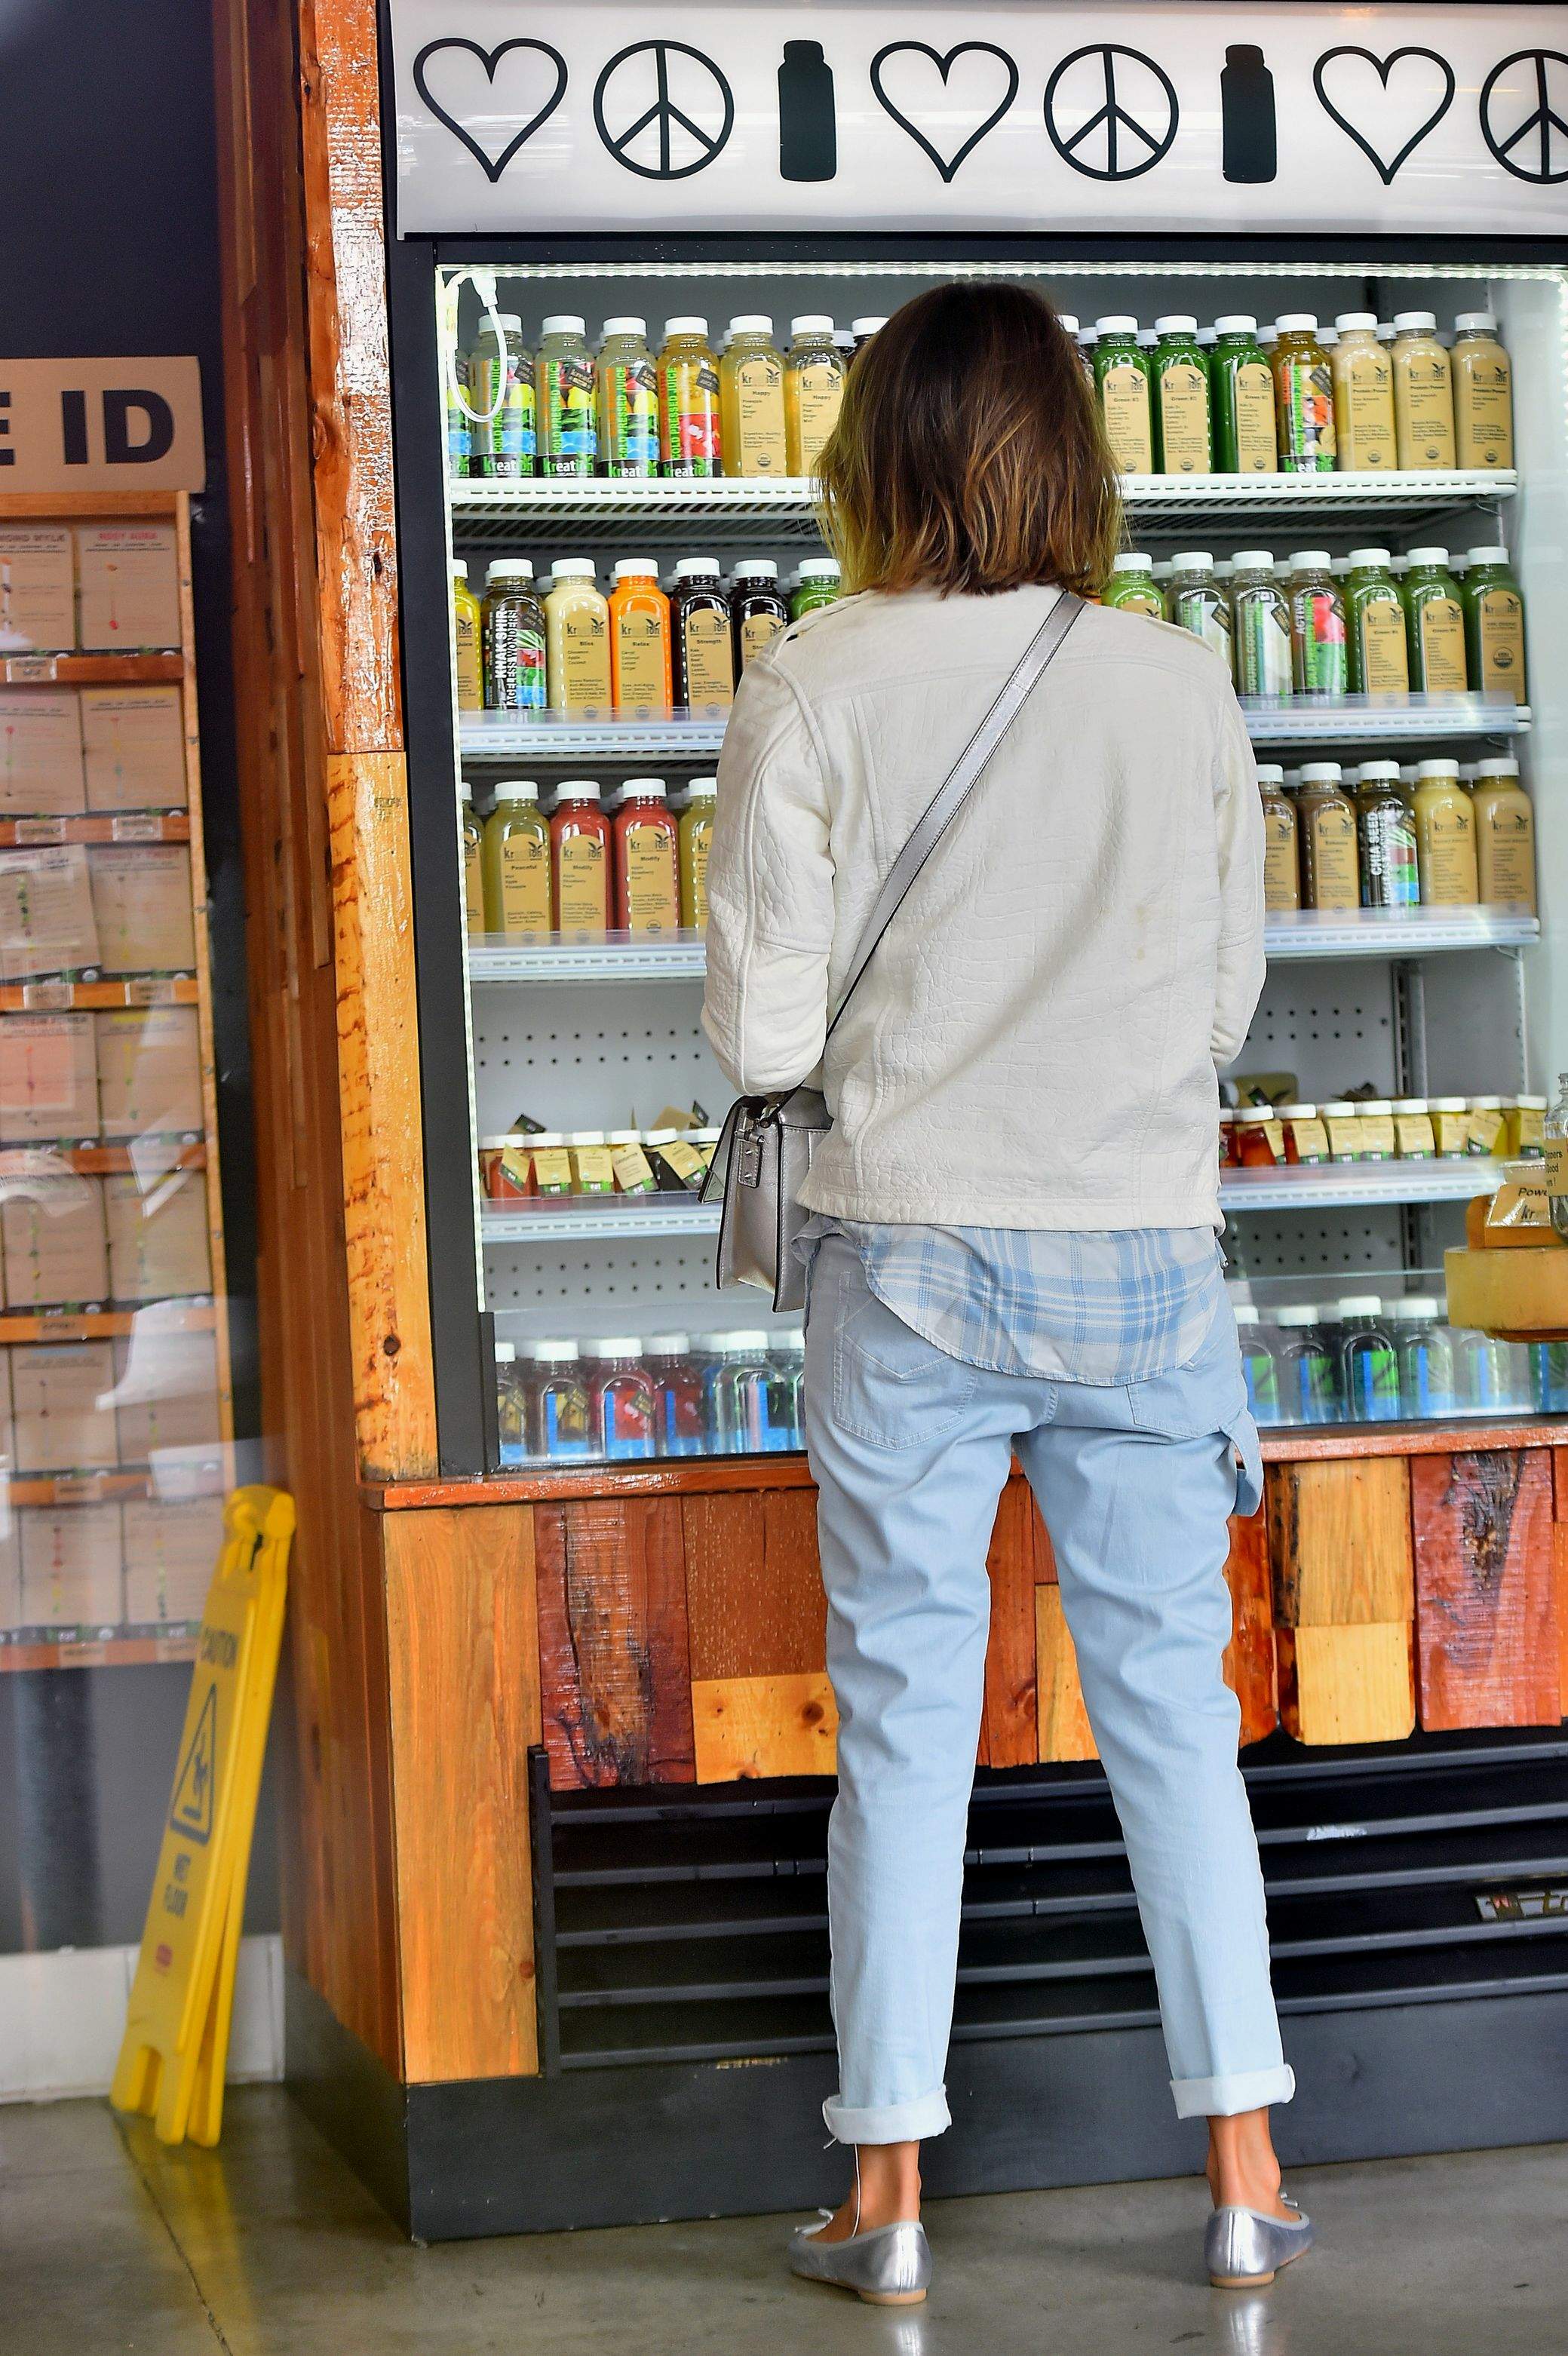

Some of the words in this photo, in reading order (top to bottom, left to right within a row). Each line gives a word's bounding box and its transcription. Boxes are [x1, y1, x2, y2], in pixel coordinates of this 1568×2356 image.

[548, 361, 559, 385] JUICE
[615, 367, 626, 391] JUICE
[667, 367, 677, 391] JUICE
[491, 388, 503, 428] PREED
[550, 389, 561, 430] PRESSED
[617, 394, 628, 434] PRESSED
[669, 395, 680, 434] PRESSED
[62, 389, 175, 465] ID
[551, 431, 561, 453] COLD
[618, 437, 628, 459] COLD
[670, 437, 680, 459] COLD
[507, 611, 518, 658] WONDERS
[495, 643, 507, 679] KHAK
[506, 661, 517, 705] AGELESS
[1367, 812, 1380, 844] SEED
[1369, 845, 1382, 875] CHIA
